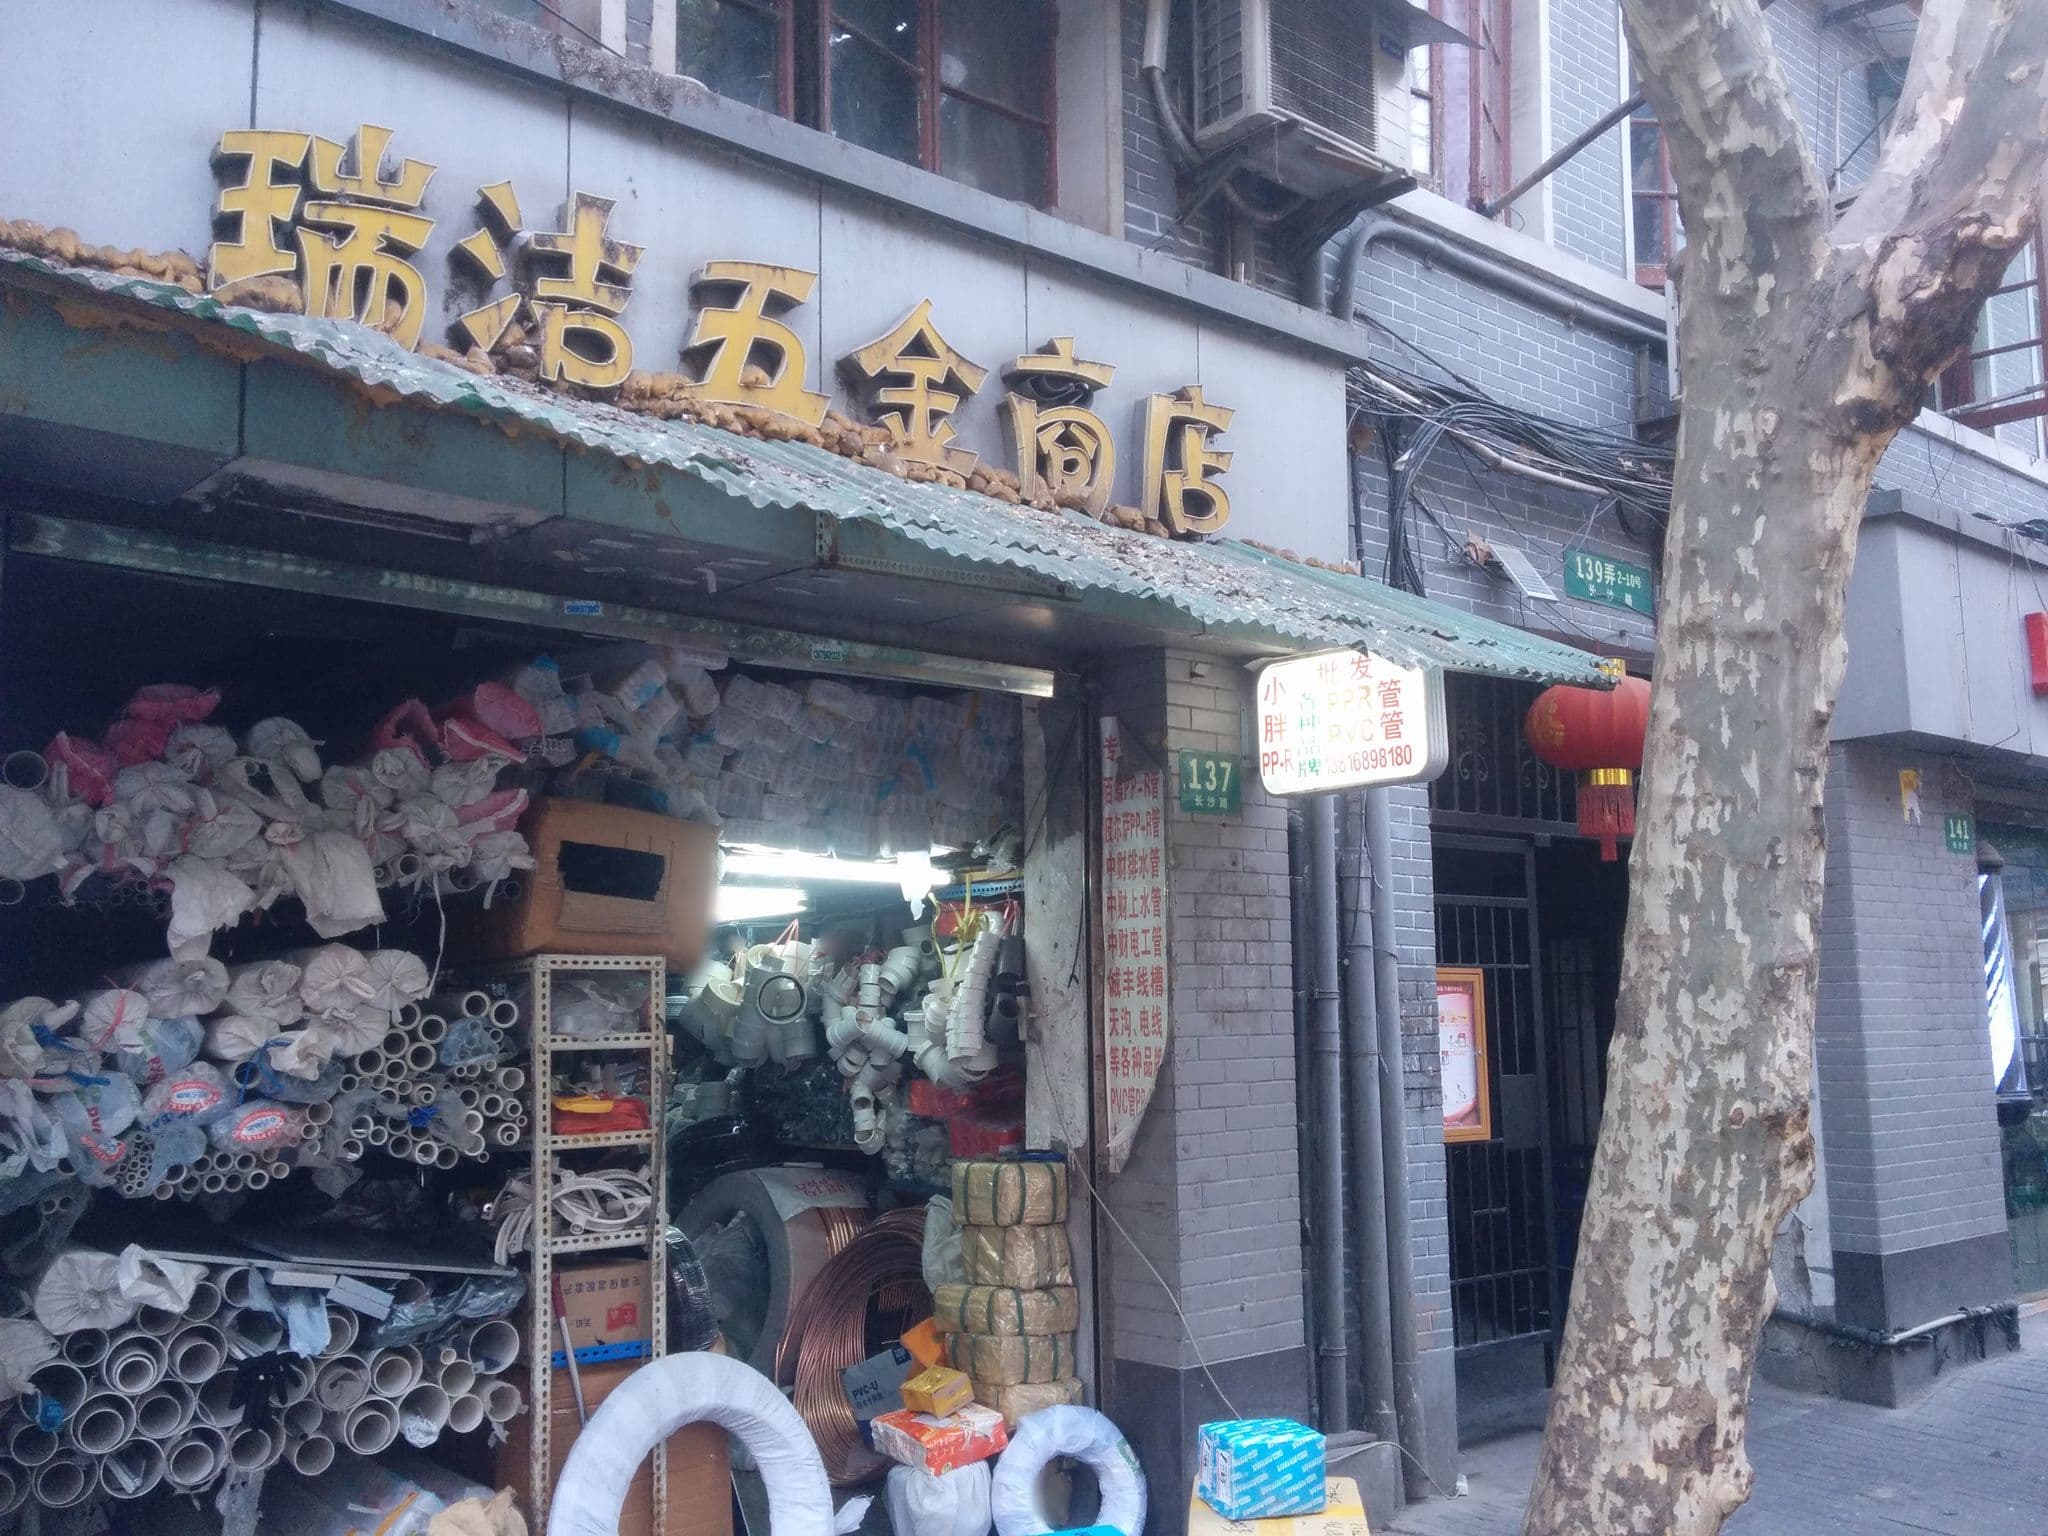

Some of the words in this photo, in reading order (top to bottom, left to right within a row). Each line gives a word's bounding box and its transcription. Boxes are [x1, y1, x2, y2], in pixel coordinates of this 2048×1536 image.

[1189, 758, 1232, 792] 137
[1949, 818, 1970, 840] 141
[1106, 846, 1160, 881] 中财排水管
[1106, 886, 1161, 921] 中财上水管
[1107, 926, 1162, 960] 中财电工管
